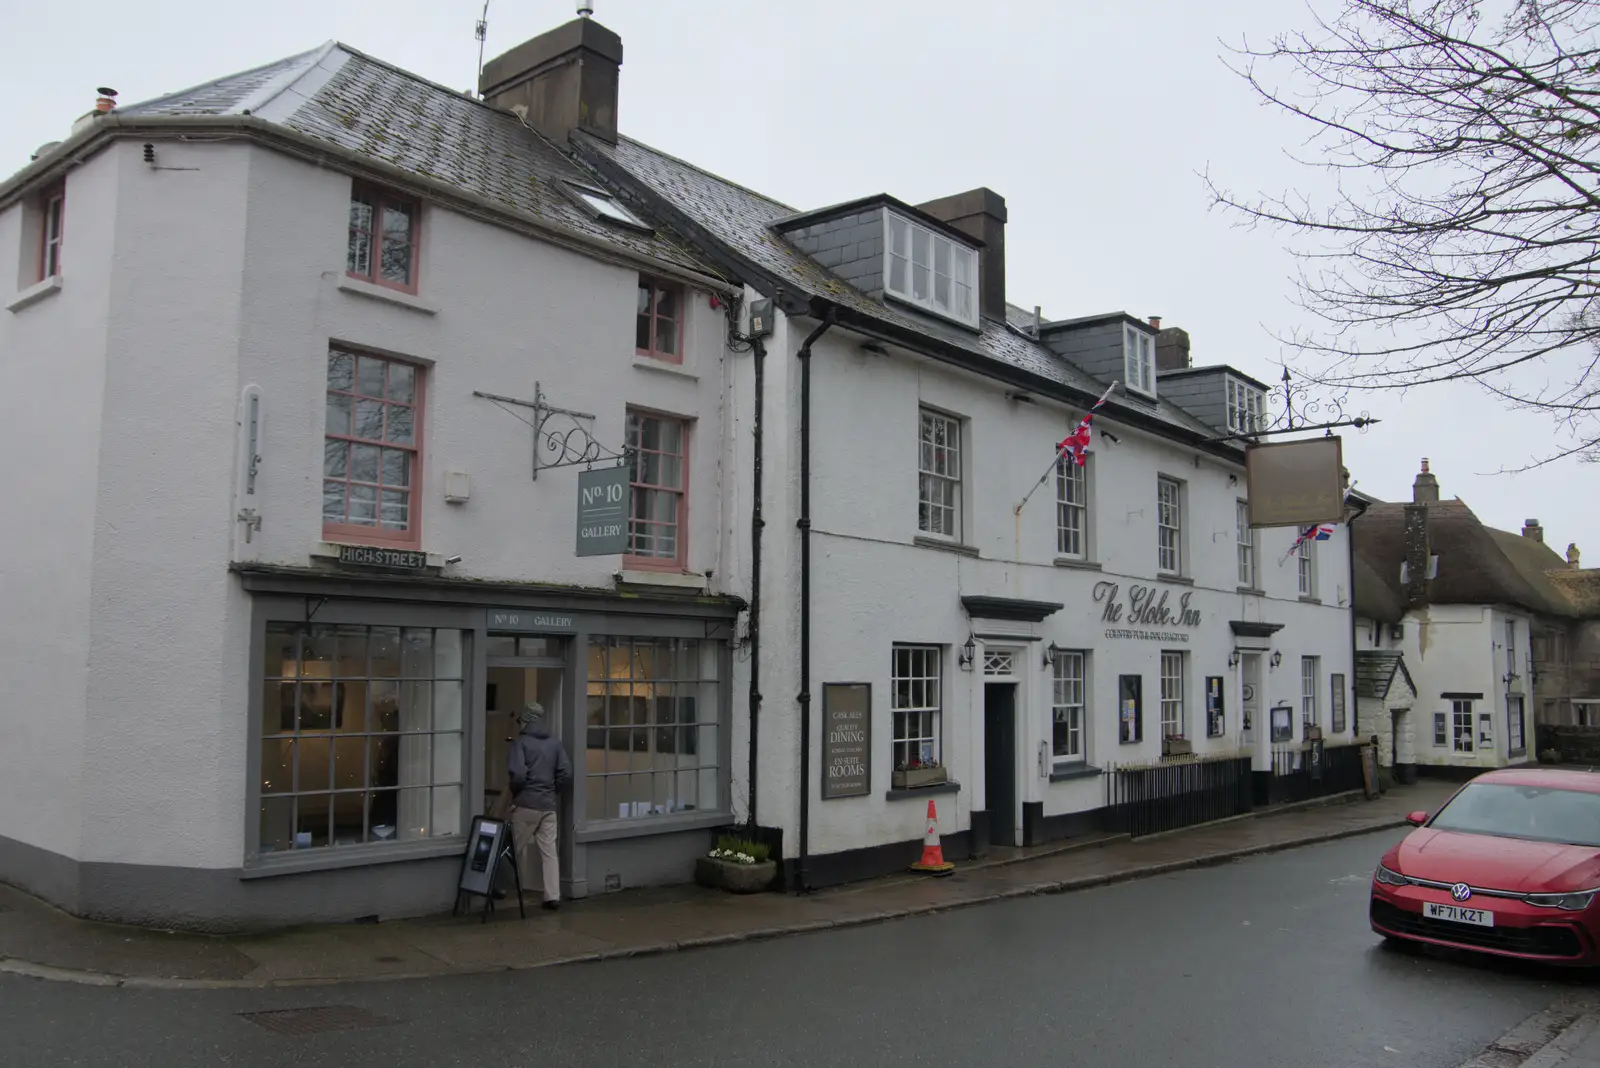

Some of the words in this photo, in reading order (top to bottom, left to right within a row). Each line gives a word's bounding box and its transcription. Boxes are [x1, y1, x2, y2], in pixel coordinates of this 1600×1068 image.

[606, 483, 623, 503] 10
[581, 524, 622, 539] GALLERY
[375, 551, 425, 567] STREET
[1093, 581, 1123, 623] The
[1127, 584, 1171, 626] Globe
[1171, 591, 1202, 627] Inn
[509, 614, 519, 625] 10
[534, 616, 572, 627] GALLERY
[830, 731, 864, 743] DINING
[829, 764, 865, 778] ROOMS
[1430, 904, 1457, 919] WF71
[1460, 907, 1485, 923] KZT
